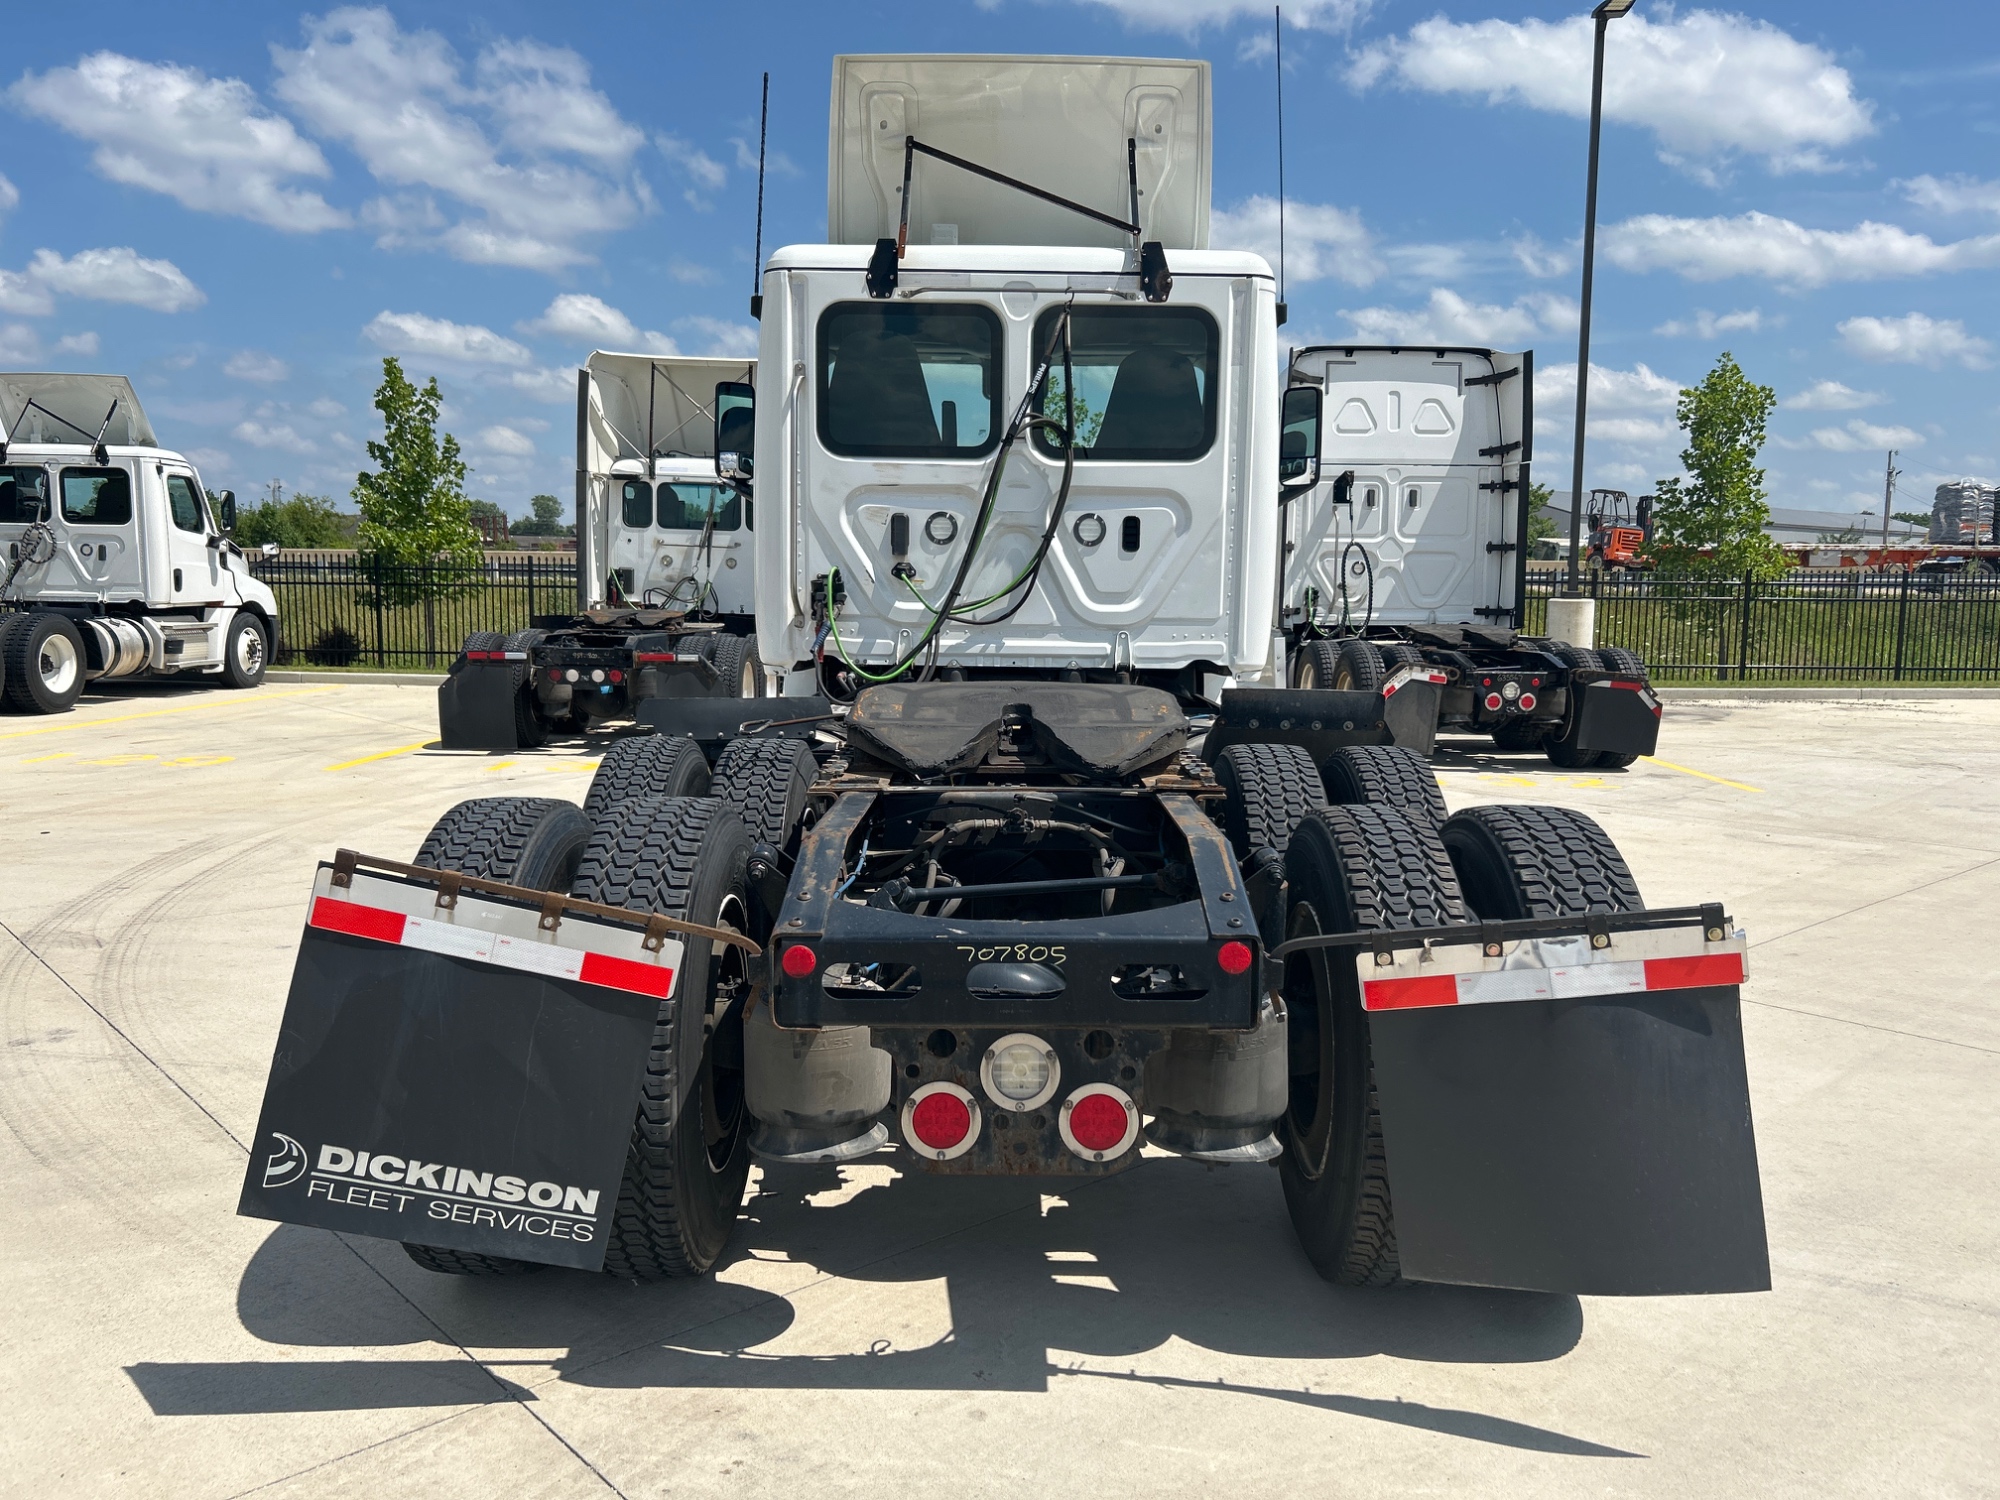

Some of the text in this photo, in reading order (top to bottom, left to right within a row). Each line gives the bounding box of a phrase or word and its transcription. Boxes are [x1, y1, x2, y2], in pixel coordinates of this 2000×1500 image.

[1028, 362, 1047, 394] PHILLIPS
[956, 943, 1067, 966] 707805
[317, 1144, 600, 1215] DICKINSON
[307, 1180, 594, 1242] FLEET SERVICES
